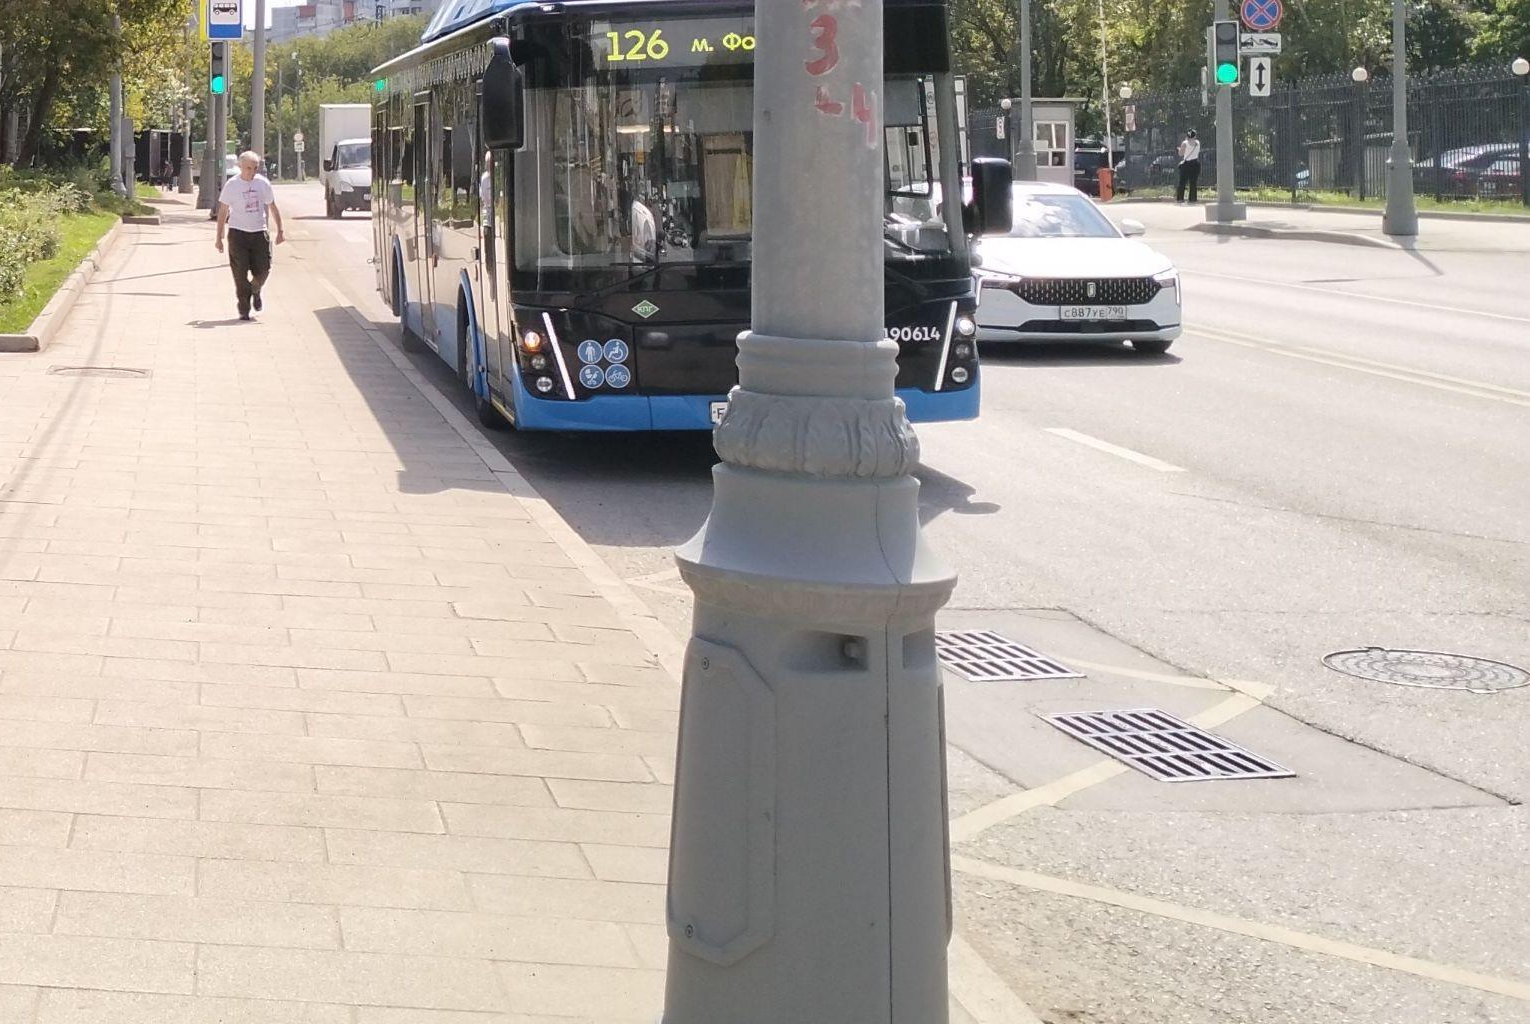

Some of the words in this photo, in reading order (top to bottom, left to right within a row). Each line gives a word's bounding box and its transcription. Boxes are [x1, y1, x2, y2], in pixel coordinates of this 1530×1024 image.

[606, 29, 669, 61] 126
[722, 32, 757, 51] Фо
[883, 326, 940, 342] 190614
